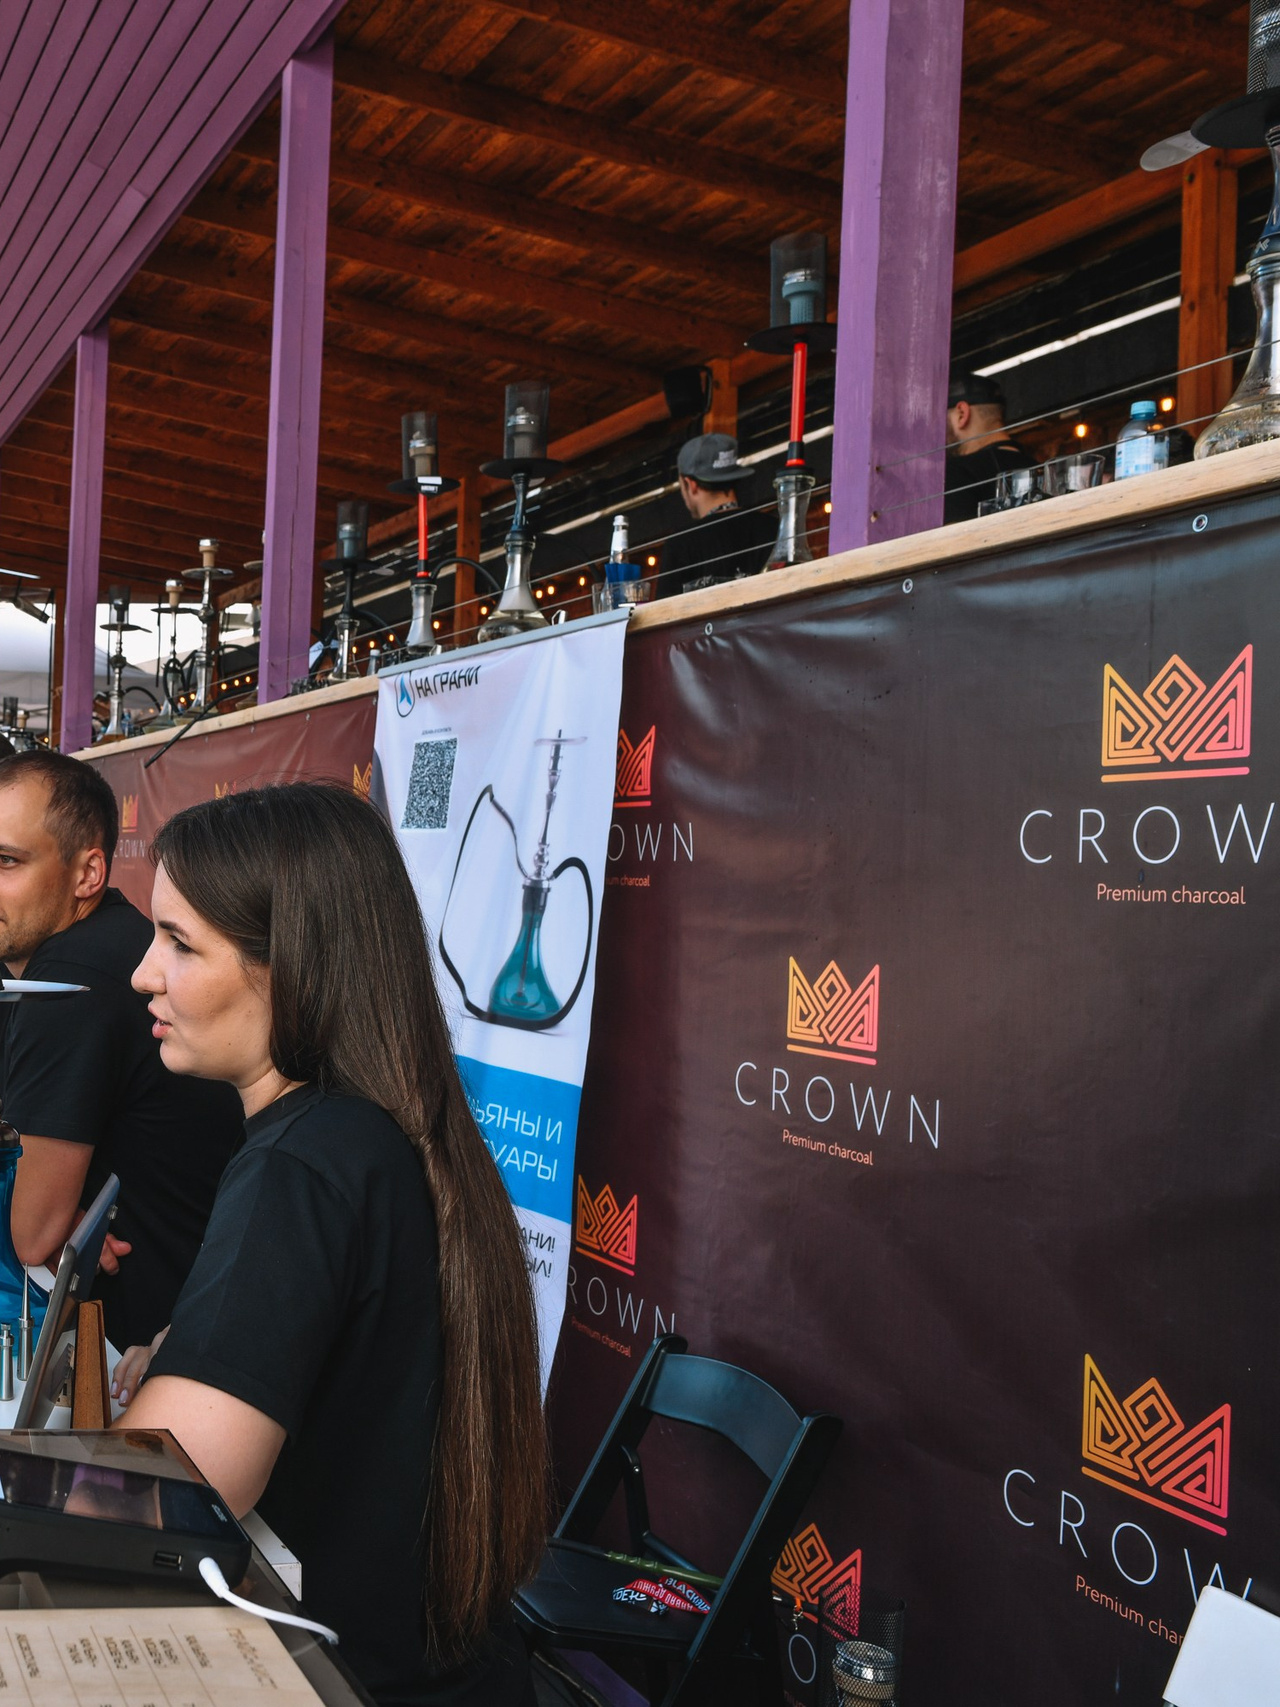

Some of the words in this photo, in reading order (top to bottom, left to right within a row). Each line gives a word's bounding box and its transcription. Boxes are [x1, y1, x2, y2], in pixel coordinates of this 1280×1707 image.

[1019, 802, 1276, 865] CROW
[1096, 883, 1168, 903] Premium
[1170, 884, 1247, 906] charcoal
[473, 1100, 542, 1139] ЬЯНЫ
[545, 1117, 563, 1145] И
[734, 1061, 940, 1149] CROWN
[781, 1129, 827, 1154] Premium
[827, 1140, 874, 1166] charcoal
[1075, 1574, 1146, 1630] Premium
